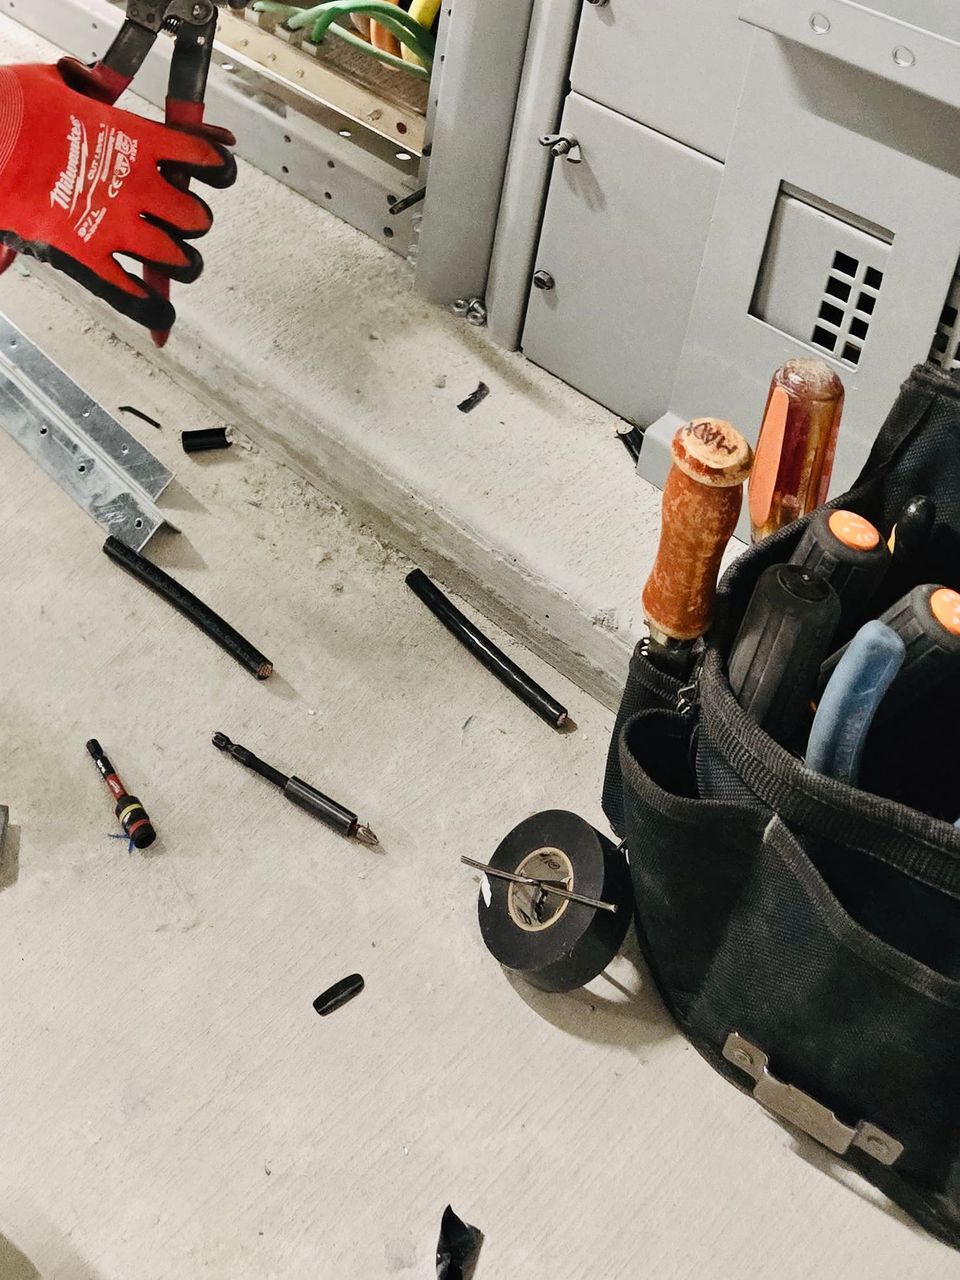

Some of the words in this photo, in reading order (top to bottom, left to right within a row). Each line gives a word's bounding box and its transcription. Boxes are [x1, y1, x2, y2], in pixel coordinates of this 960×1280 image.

[50, 117, 81, 210] Milwaukee
[88, 160, 98, 180] CUT
[94, 130, 106, 159] LEVEL
